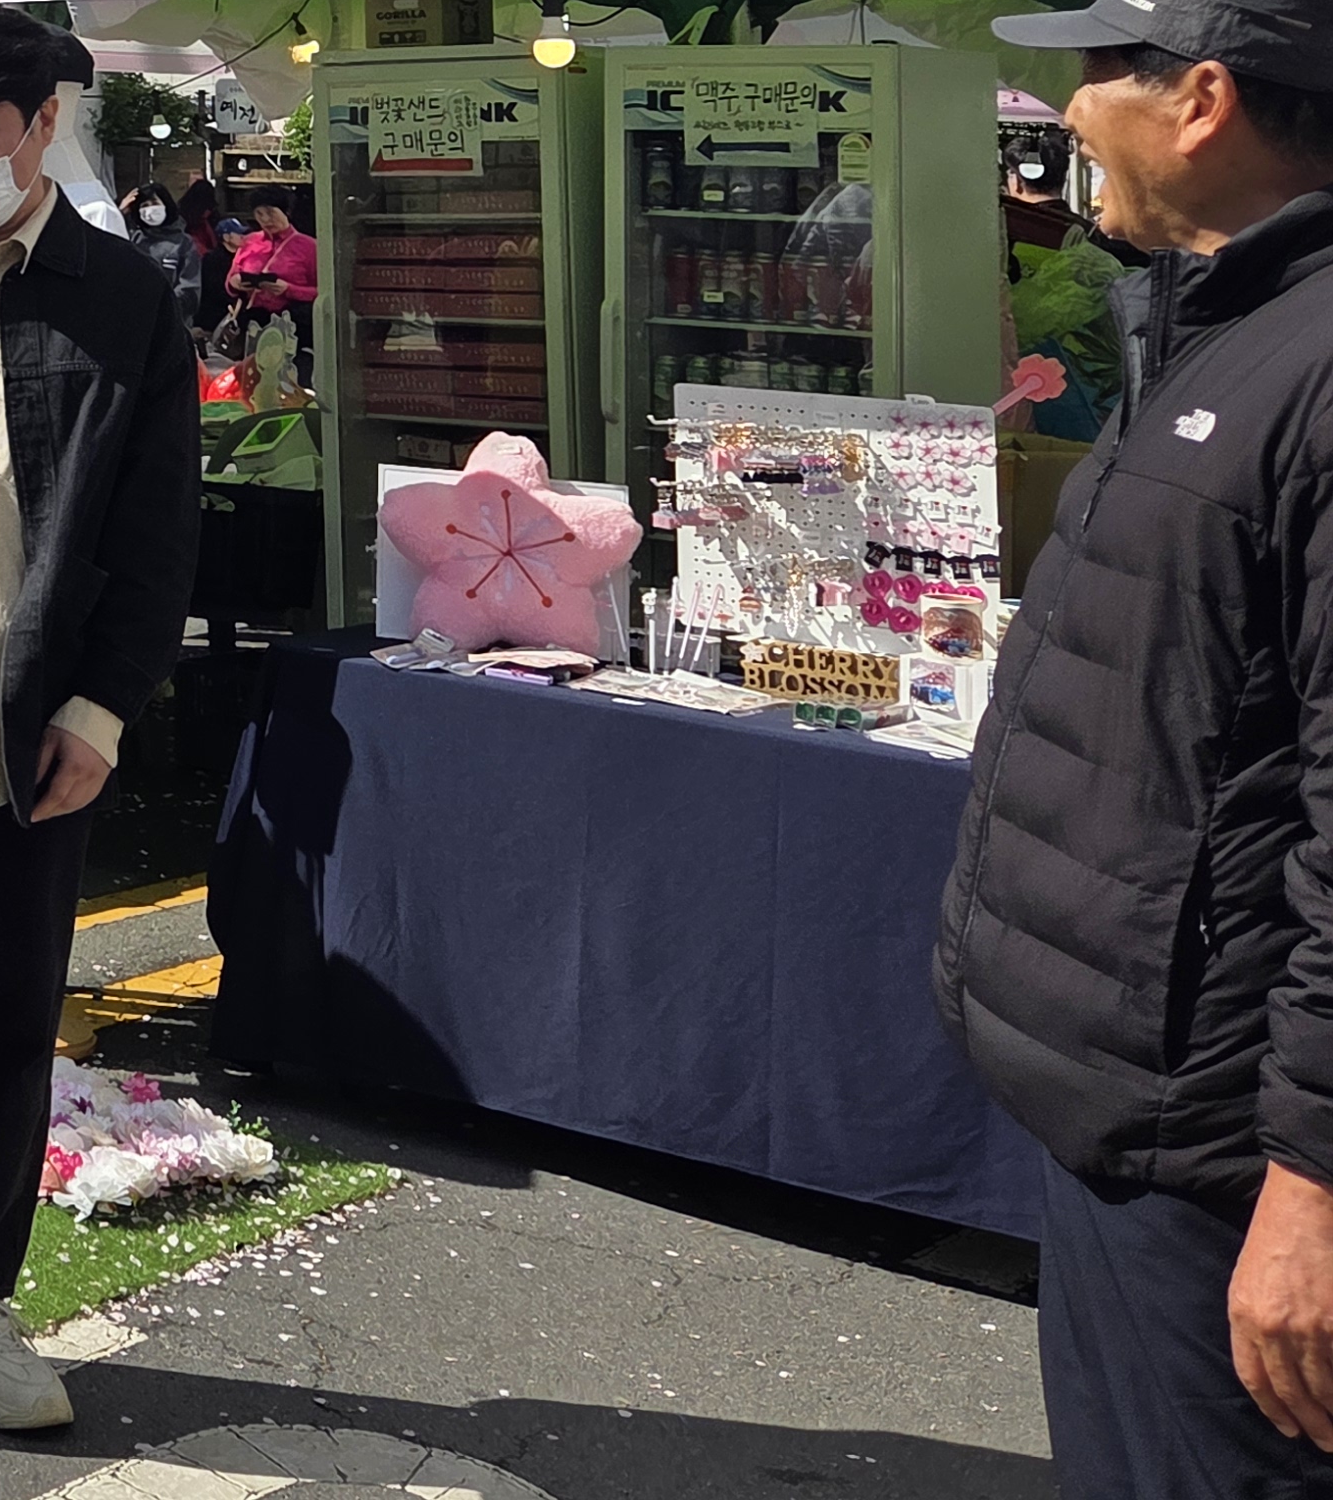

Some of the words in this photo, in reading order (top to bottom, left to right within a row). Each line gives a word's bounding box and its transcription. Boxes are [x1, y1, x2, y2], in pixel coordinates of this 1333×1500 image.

[375, 8, 427, 21] GORILLA
[764, 643, 897, 682] CHERRY
[744, 666, 895, 700] BLOSSOM
